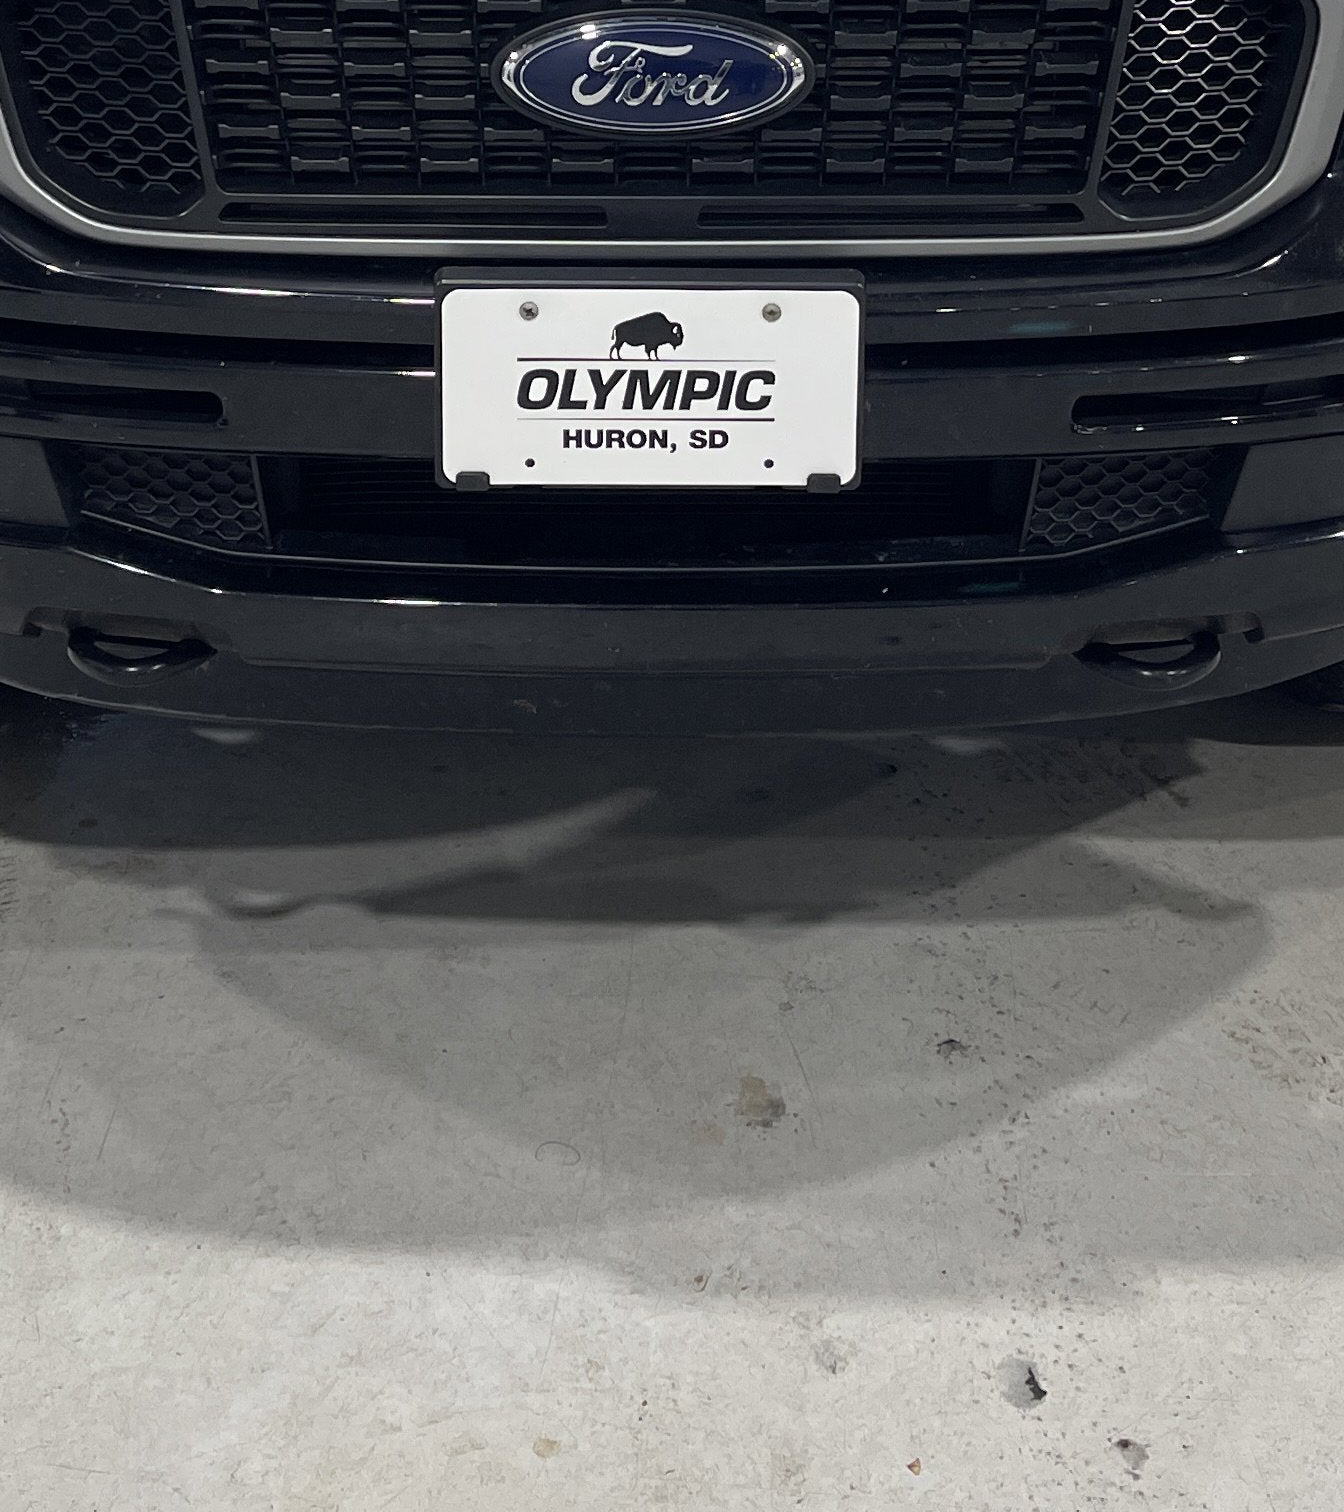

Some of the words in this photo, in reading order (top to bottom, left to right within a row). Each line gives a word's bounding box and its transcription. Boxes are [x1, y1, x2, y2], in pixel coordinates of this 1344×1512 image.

[571, 40, 734, 106] Ford
[516, 368, 776, 411] OLYMPIC
[562, 429, 678, 453] HURON,
[688, 429, 729, 449] SD
